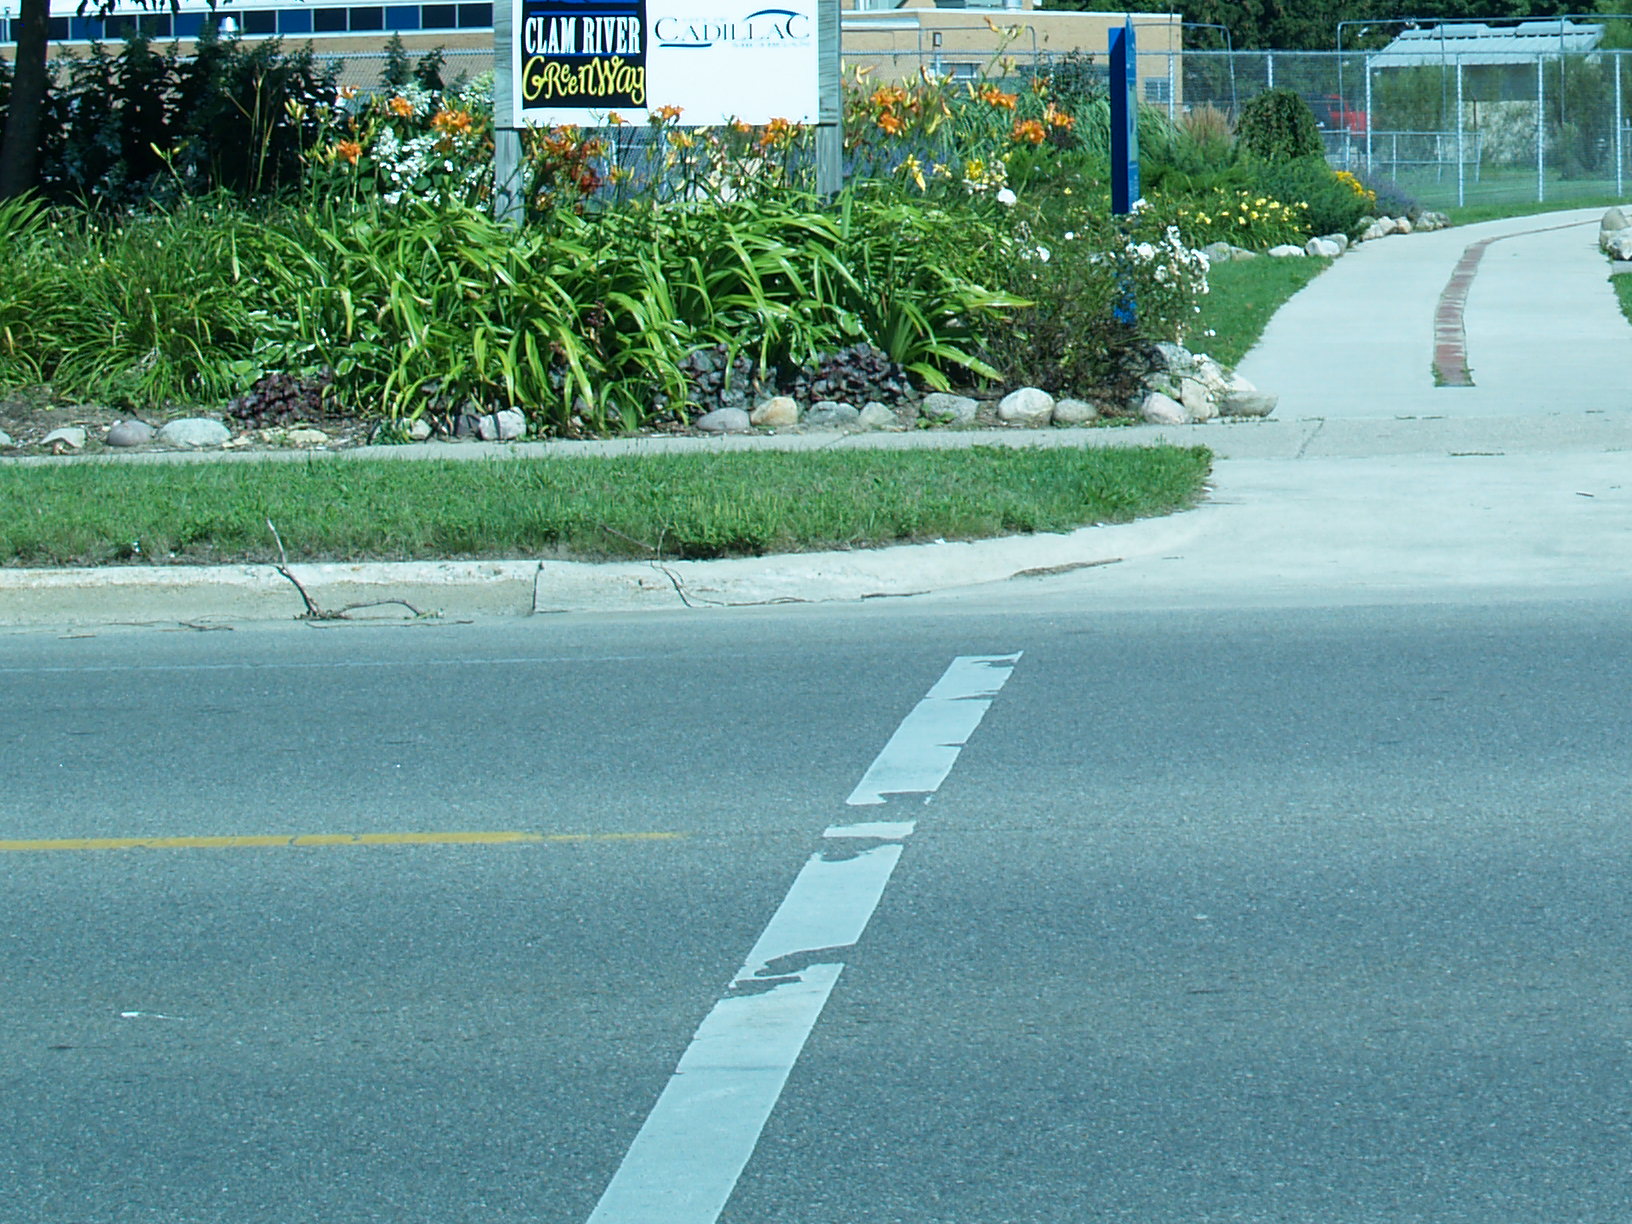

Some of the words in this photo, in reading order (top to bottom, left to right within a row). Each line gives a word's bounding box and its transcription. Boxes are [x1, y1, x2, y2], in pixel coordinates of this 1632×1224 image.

[525, 17, 577, 54] CLAM
[582, 17, 641, 54] RIVER
[655, 14, 810, 42] CADILLAC
